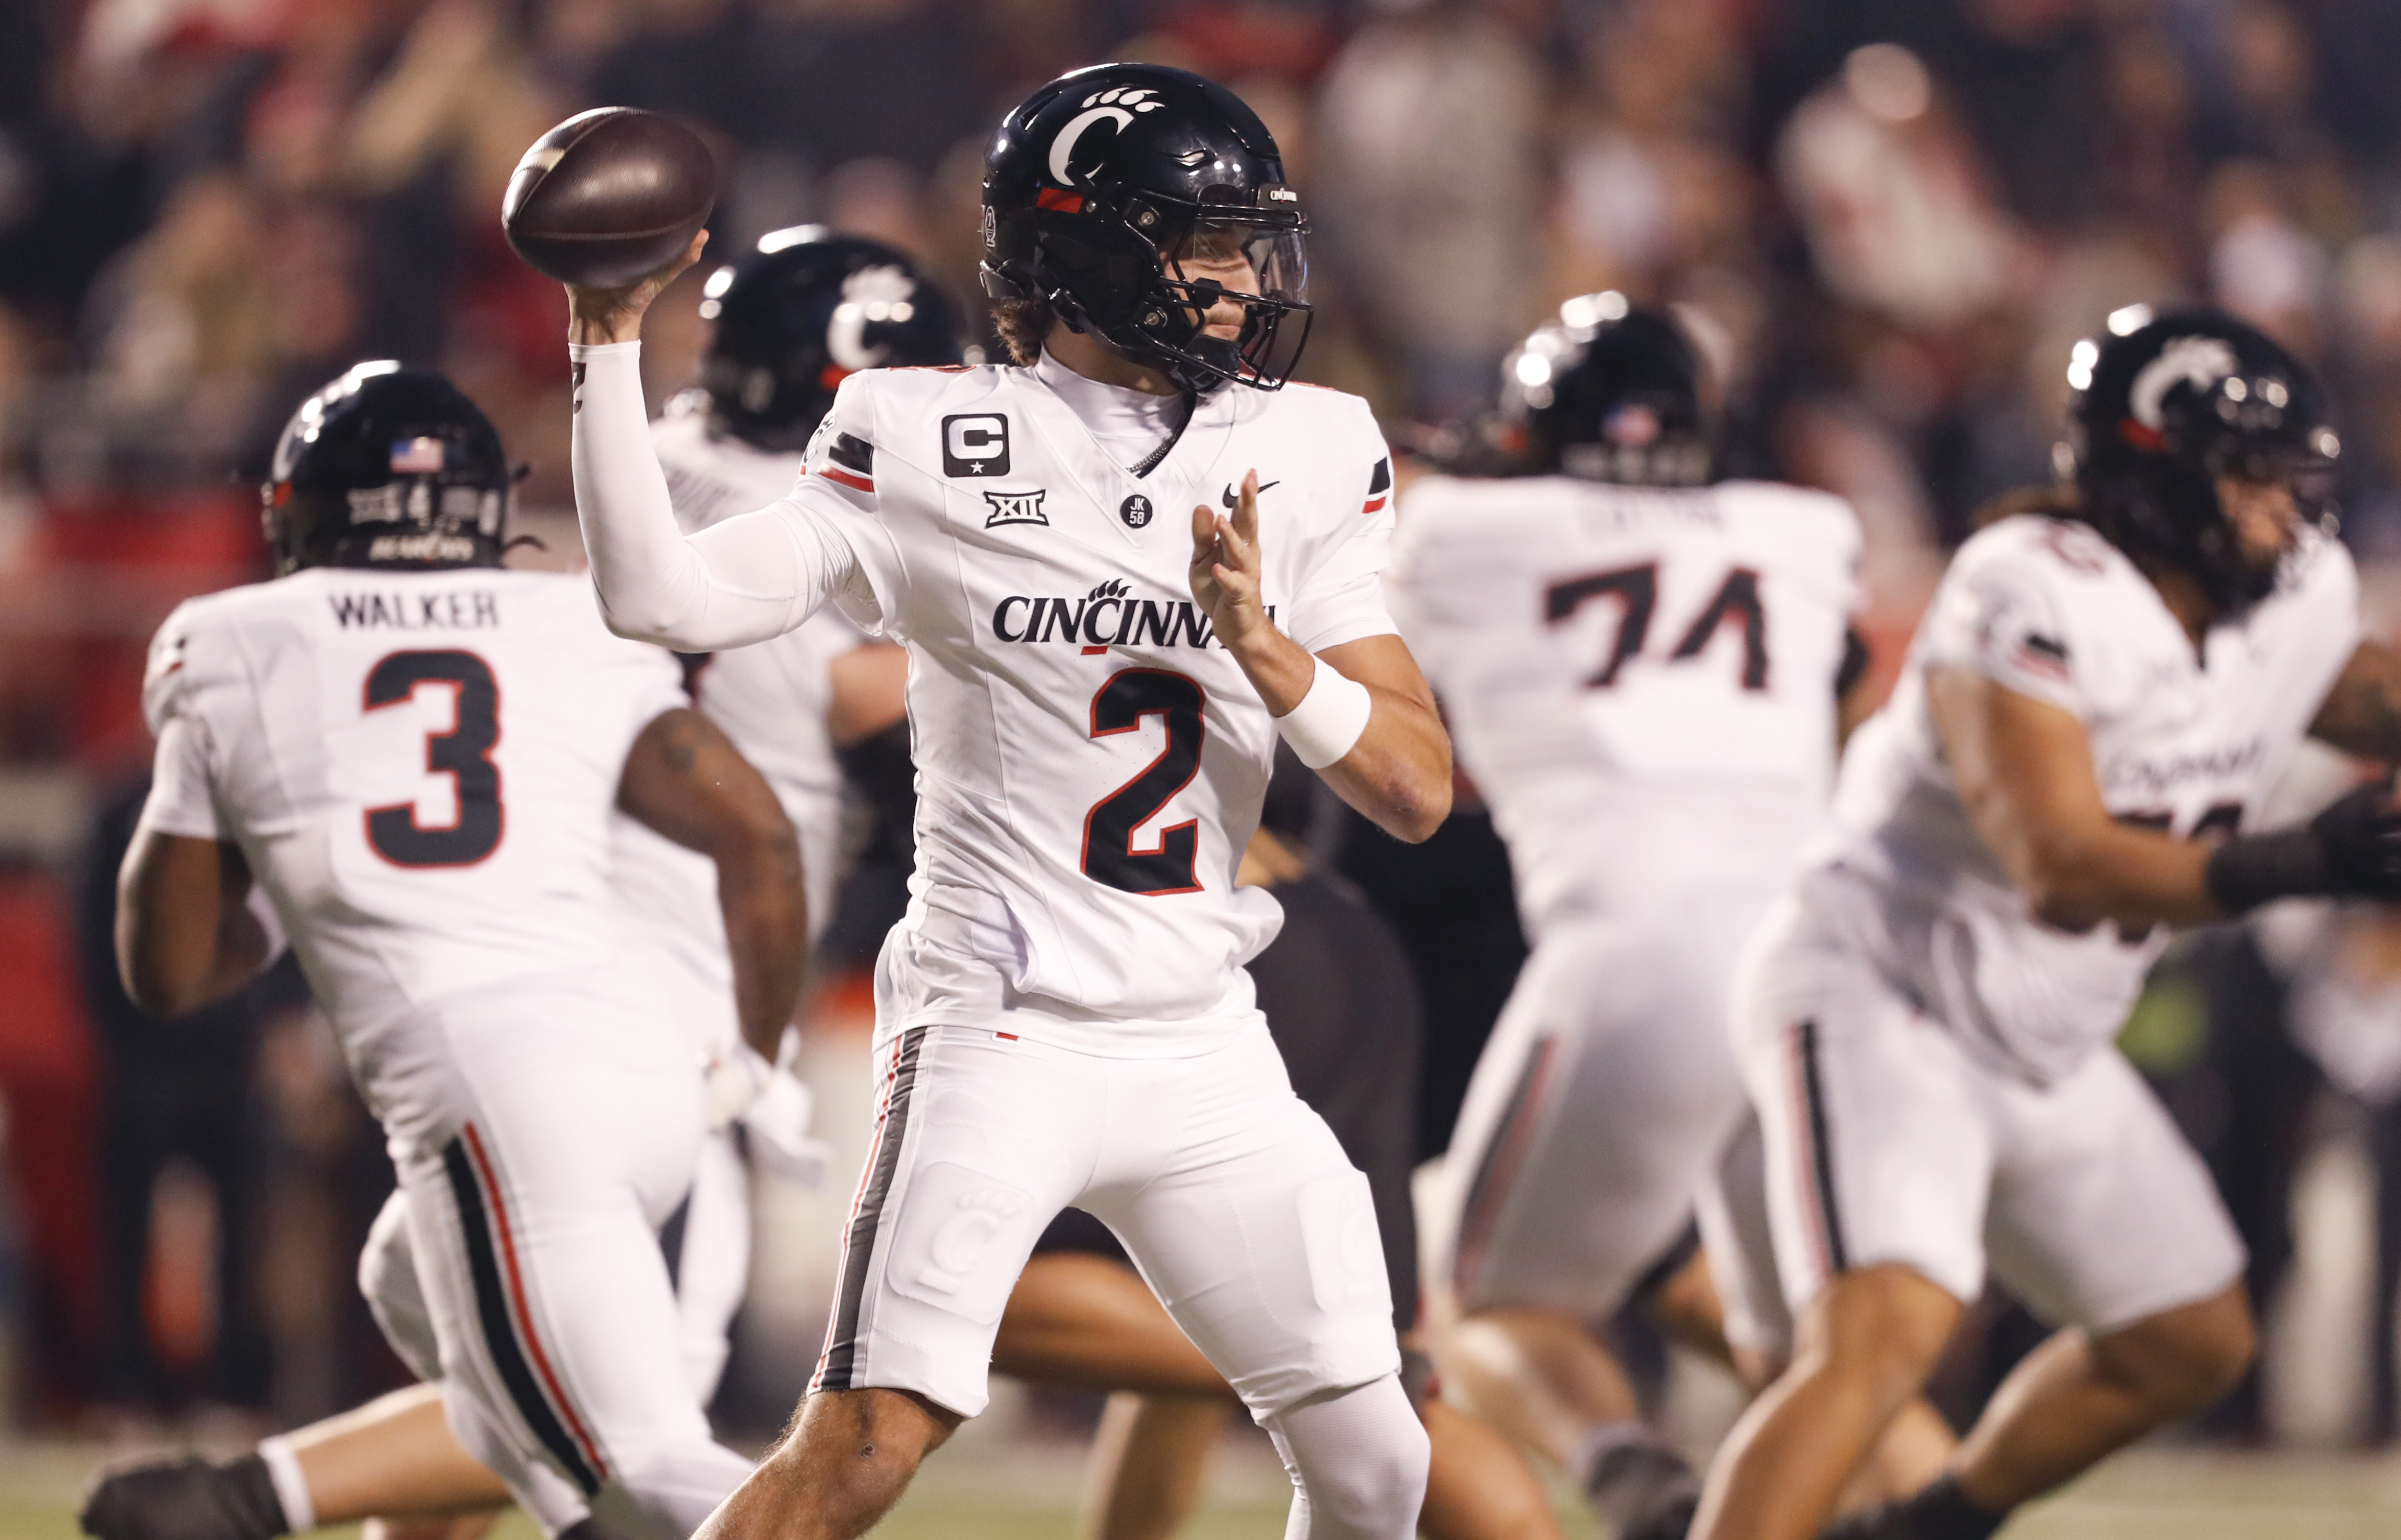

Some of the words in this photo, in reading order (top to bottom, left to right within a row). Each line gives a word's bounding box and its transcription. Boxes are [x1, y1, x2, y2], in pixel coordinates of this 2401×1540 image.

[948, 417, 1004, 460] C
[986, 493, 1046, 523] XII
[1129, 511, 1145, 525] 58
[1130, 498, 1145, 511] JK
[329, 593, 499, 629] WALKER
[993, 596, 1276, 649] CINCINN
[363, 649, 504, 867] 3
[1080, 667, 1205, 897] 2
